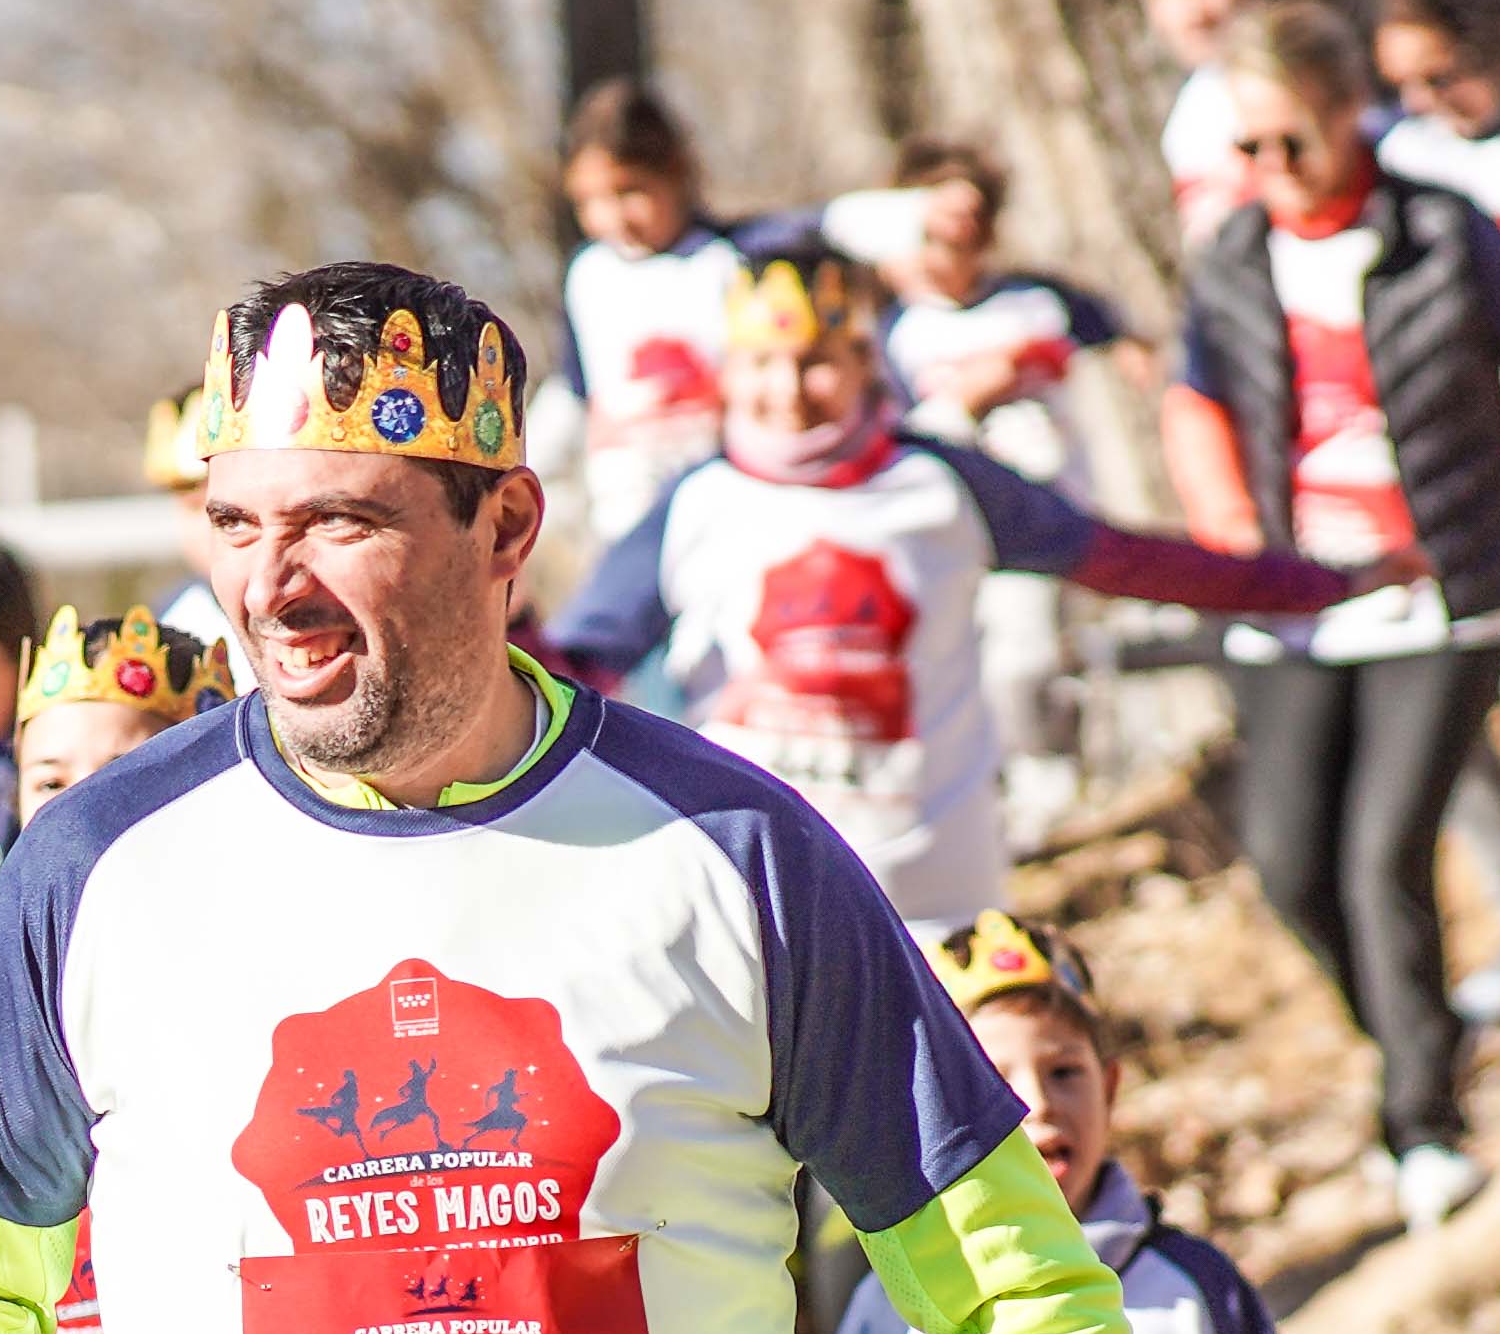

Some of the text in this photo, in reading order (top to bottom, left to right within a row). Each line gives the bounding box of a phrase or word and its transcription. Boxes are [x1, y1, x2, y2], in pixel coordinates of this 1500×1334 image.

[323, 1152, 533, 1183] CARRERA POPULAR
[410, 1175, 444, 1188] de los
[305, 1179, 561, 1244] REYES MAGOS
